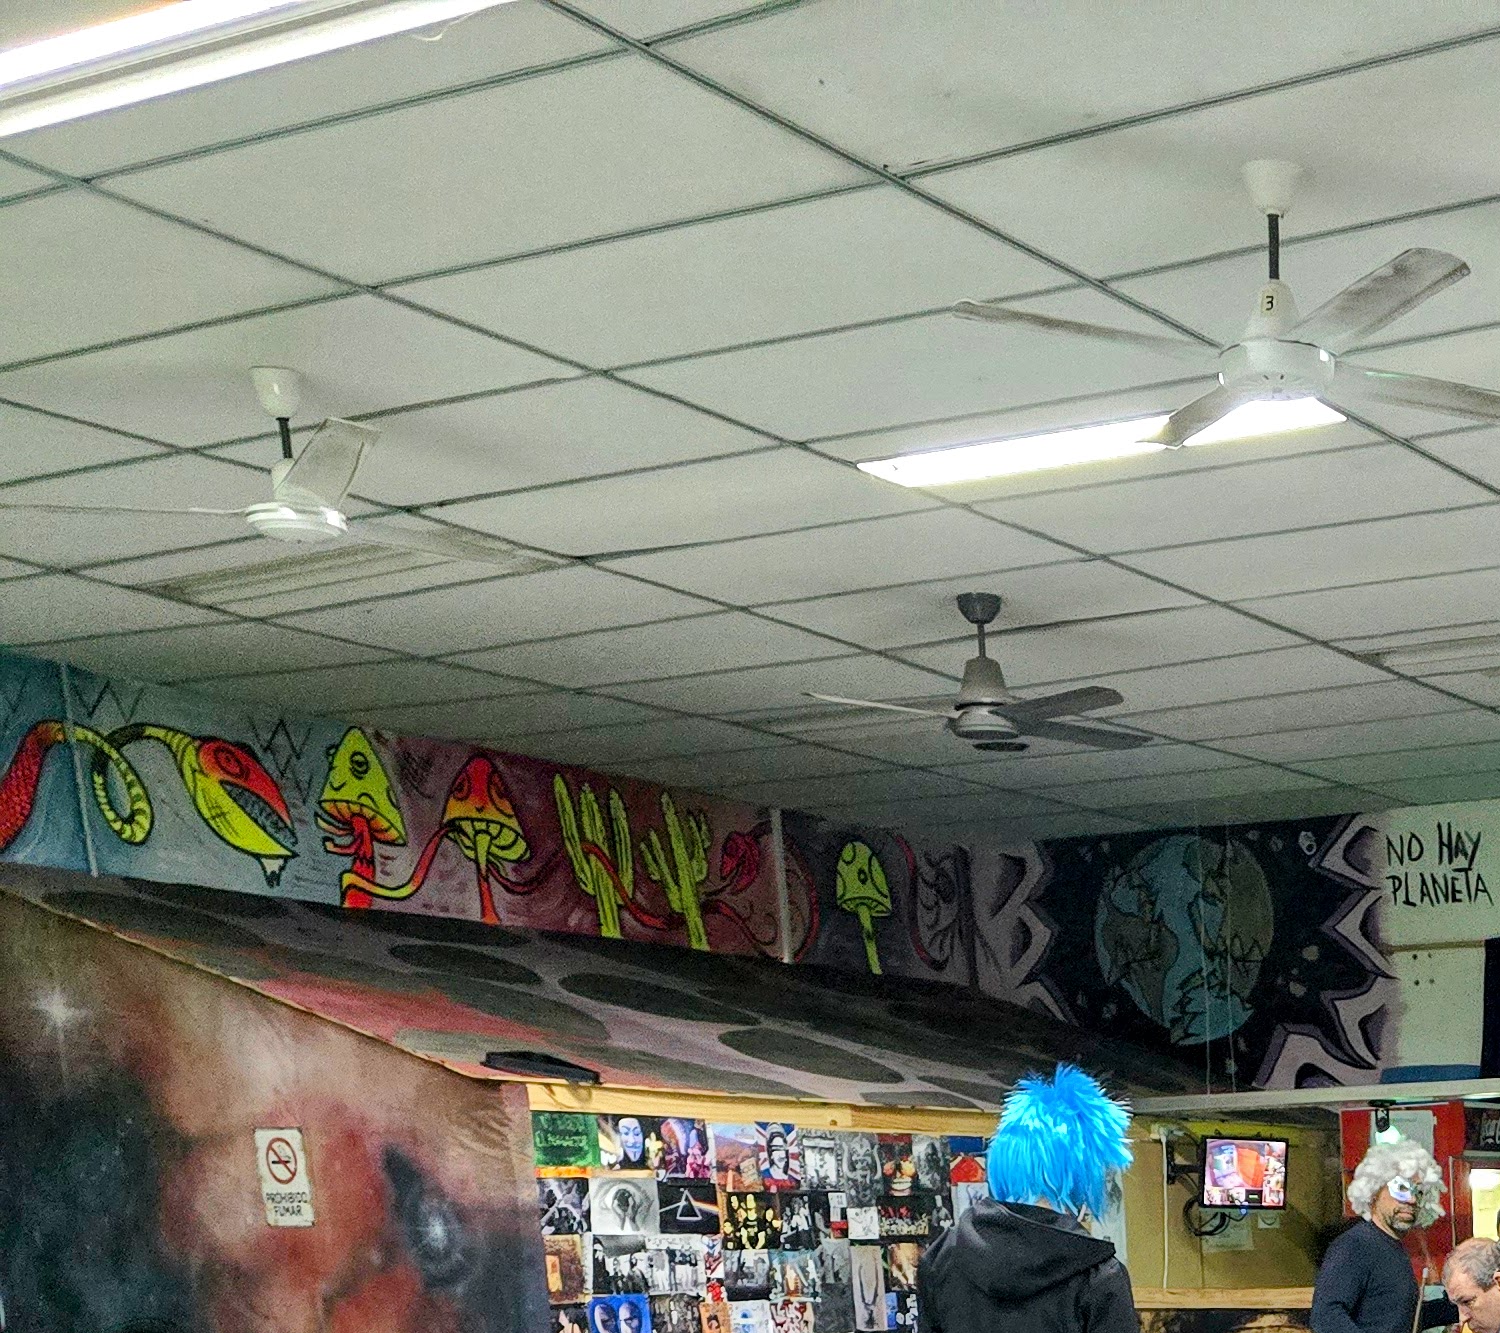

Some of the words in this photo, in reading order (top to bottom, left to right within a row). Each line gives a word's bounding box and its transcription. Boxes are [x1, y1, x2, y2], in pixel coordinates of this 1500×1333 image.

[1265, 295, 1274, 311] 3
[1386, 832, 1424, 867] NO
[1437, 821, 1482, 869] HAY
[1386, 867, 1495, 908] PLANETA
